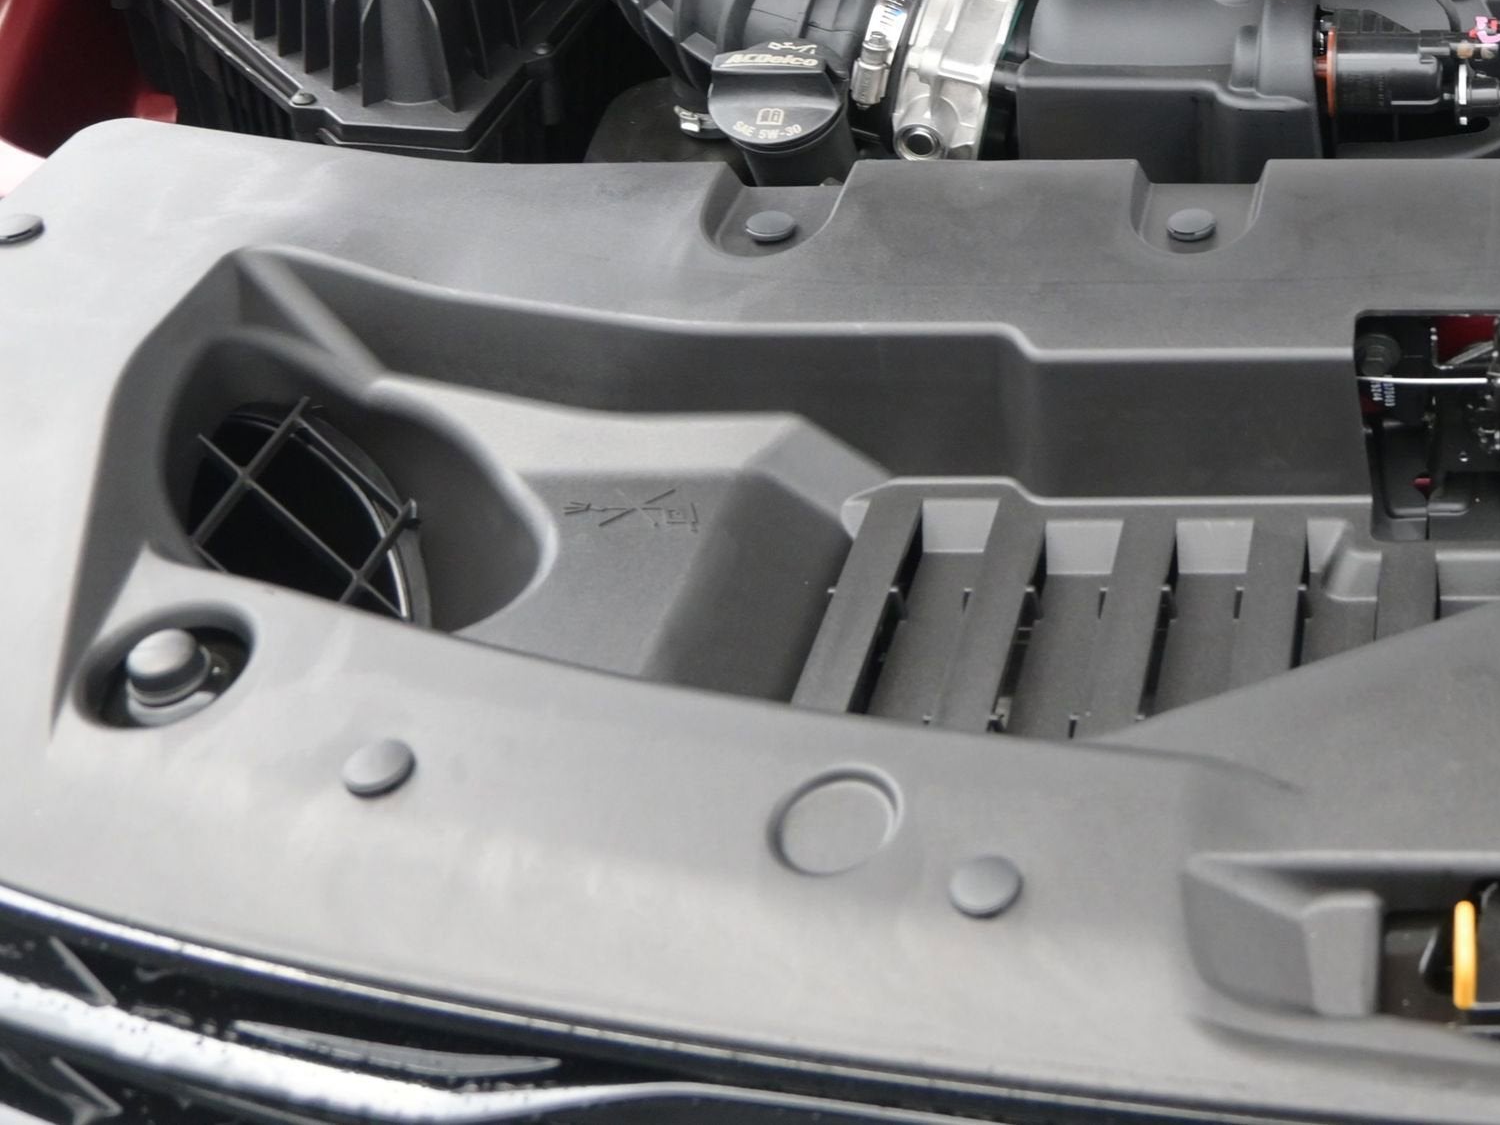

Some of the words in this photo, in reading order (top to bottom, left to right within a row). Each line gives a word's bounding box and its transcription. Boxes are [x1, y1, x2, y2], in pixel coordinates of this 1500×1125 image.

[724, 53, 818, 67] ACDelco
[732, 120, 757, 138] SAE
[757, 123, 802, 140] 5W-30
